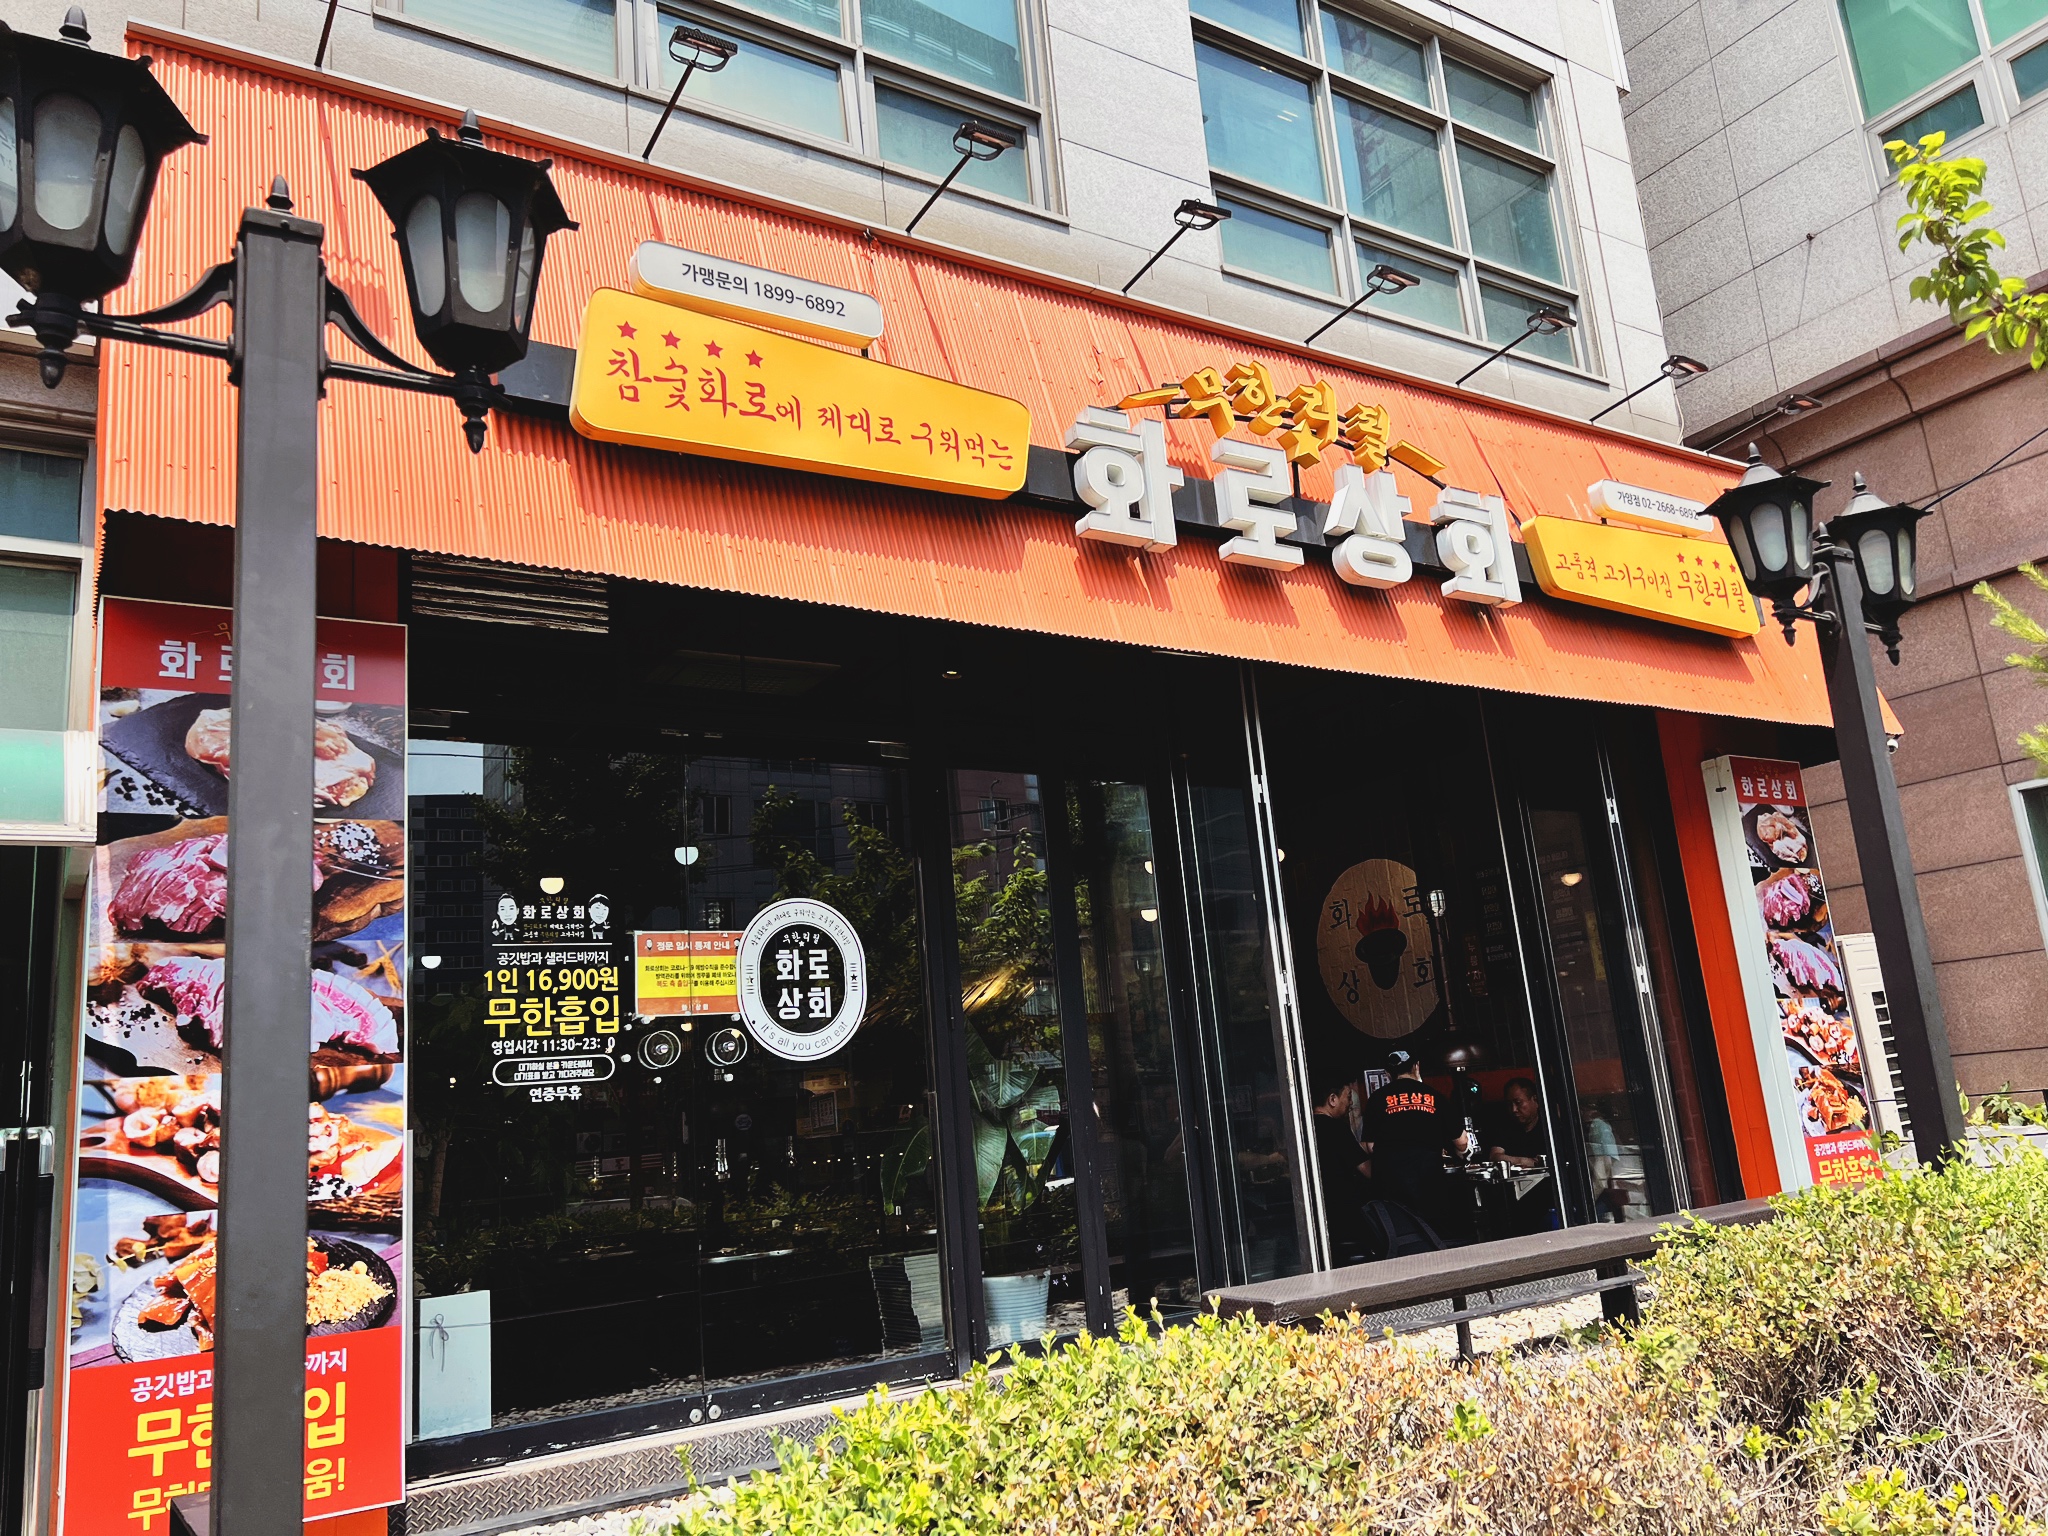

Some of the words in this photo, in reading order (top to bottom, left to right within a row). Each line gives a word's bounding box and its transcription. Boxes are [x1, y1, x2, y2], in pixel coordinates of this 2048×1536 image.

[681, 262, 749, 296] 가맹문의
[753, 281, 846, 317] 1899-6892
[1178, 360, 1392, 474] 무한리필
[817, 402, 901, 445] 제대로
[910, 422, 1014, 471] 구워먹는
[1065, 405, 1523, 609] 화로상회
[1617, 491, 1641, 507] 가양점
[1642, 497, 1699, 521] 02-2668-6892
[1555, 552, 1598, 583] 고품격
[1604, 563, 1673, 599] 고기구이집
[1677, 570, 1747, 613] 무한리필
[1741, 776, 1798, 800] 화로상회
[522, 905, 585, 920] 화로상회
[496, 952, 542, 966] 공깃밥과
[544, 951, 609, 965] 샐러드바까지
[676, 941, 692, 950] 임시
[713, 941, 730, 950] 안내
[483, 967, 519, 994] 1인
[526, 966, 619, 994] 16,900원
[775, 949, 831, 981] 화로
[483, 995, 620, 1038] 무한흡입
[777, 987, 832, 1020] 상회
[491, 1039, 539, 1056] 영업시간
[542, 1037, 616, 1052] 11:30~23:0
[760, 1023, 776, 1040] It's
[777, 1037, 790, 1047] all
[792, 1043, 811, 1051] you
[814, 1035, 833, 1049] can
[834, 1021, 848, 1037] eat
[529, 1085, 582, 1102] 연중무휴
[1385, 1092, 1435, 1107] 화로상회
[1837, 1139, 1871, 1154] 샐러드바까
